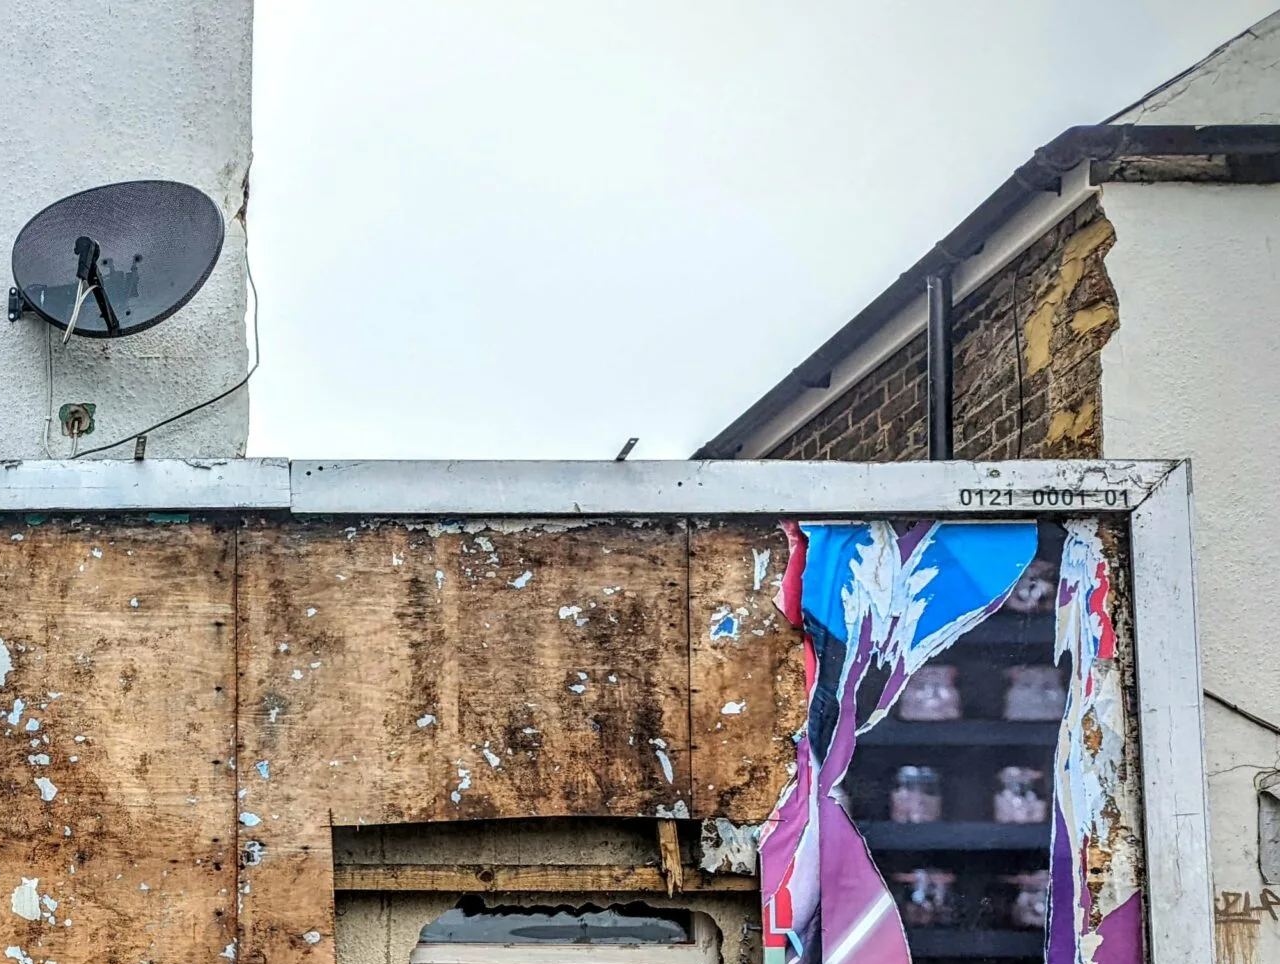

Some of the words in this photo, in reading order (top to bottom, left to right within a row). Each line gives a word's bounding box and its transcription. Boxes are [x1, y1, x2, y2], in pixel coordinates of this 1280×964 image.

[959, 488, 1013, 506] 0121
[1032, 488, 1086, 506] 0001
[1104, 489, 1129, 508] 01
